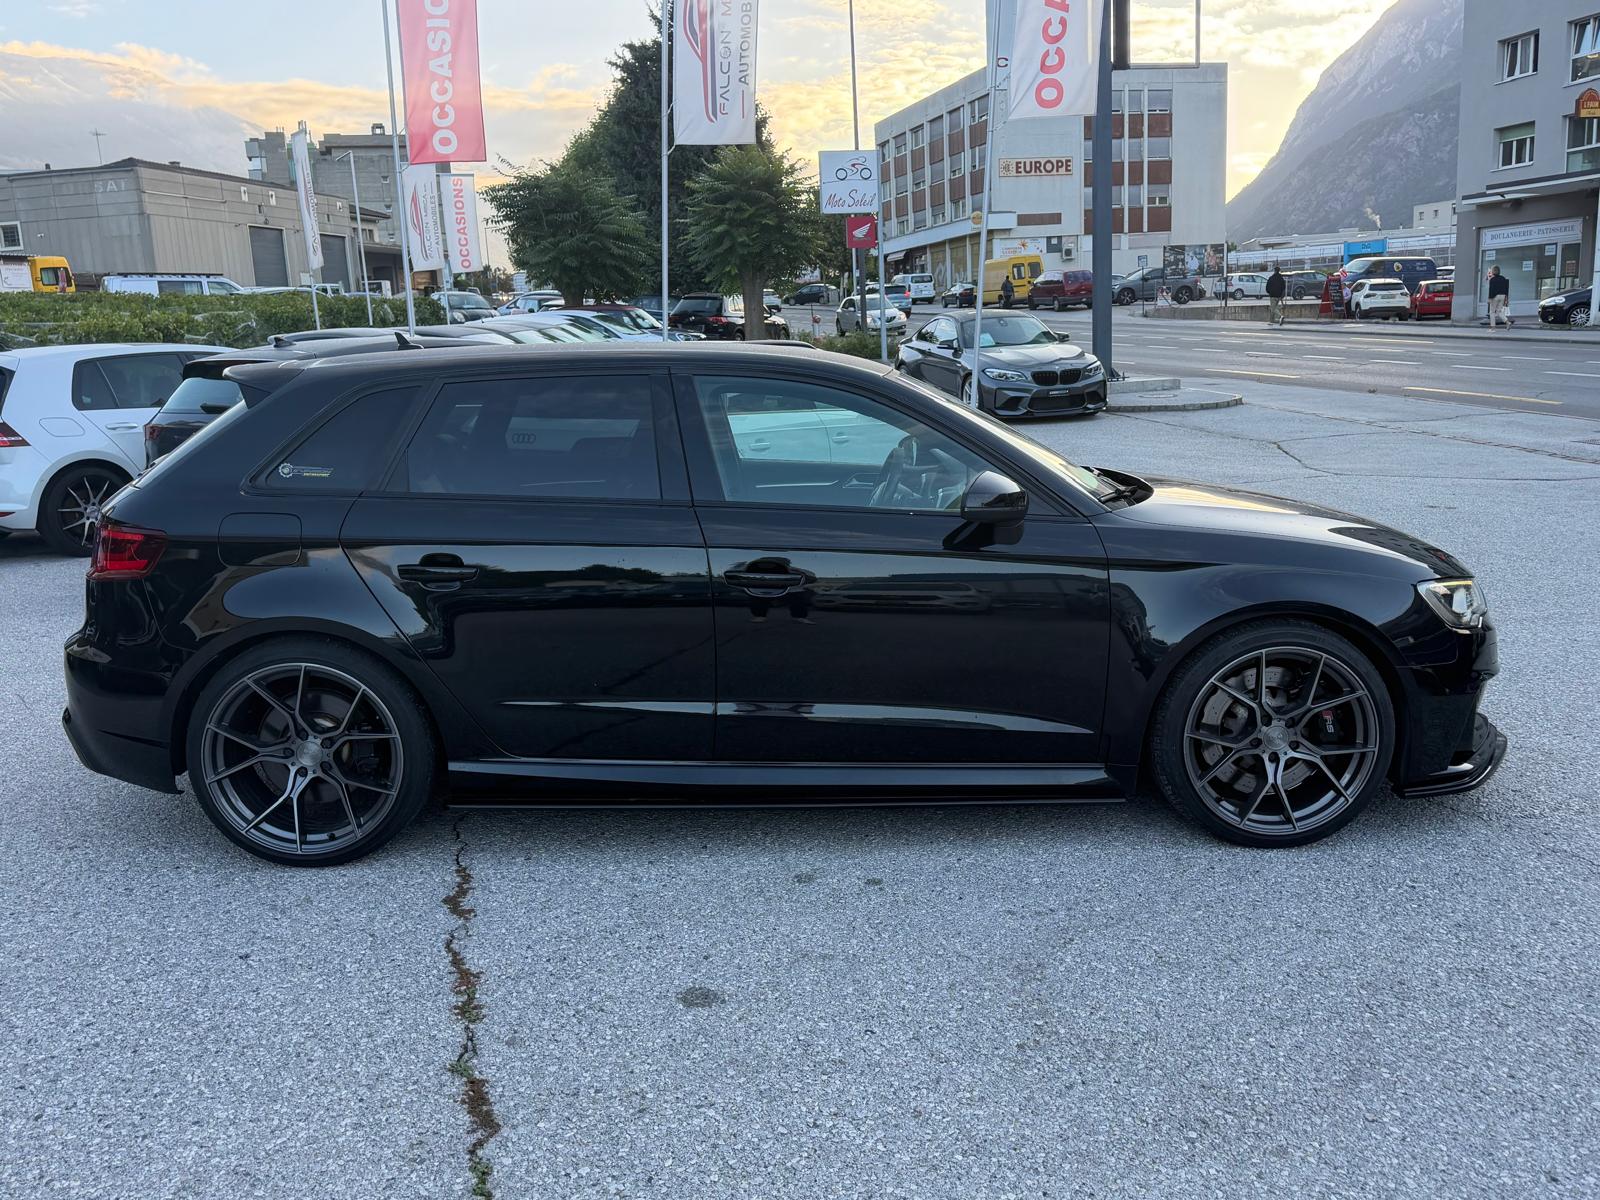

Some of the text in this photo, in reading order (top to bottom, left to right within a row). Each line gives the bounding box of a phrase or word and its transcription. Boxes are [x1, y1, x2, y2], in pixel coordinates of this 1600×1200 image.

[719, 30, 732, 116] FALCON
[1015, 159, 1072, 174] EUROPE
[452, 178, 471, 269] OCCASIONS
[824, 188, 877, 209] Moto Soleil
